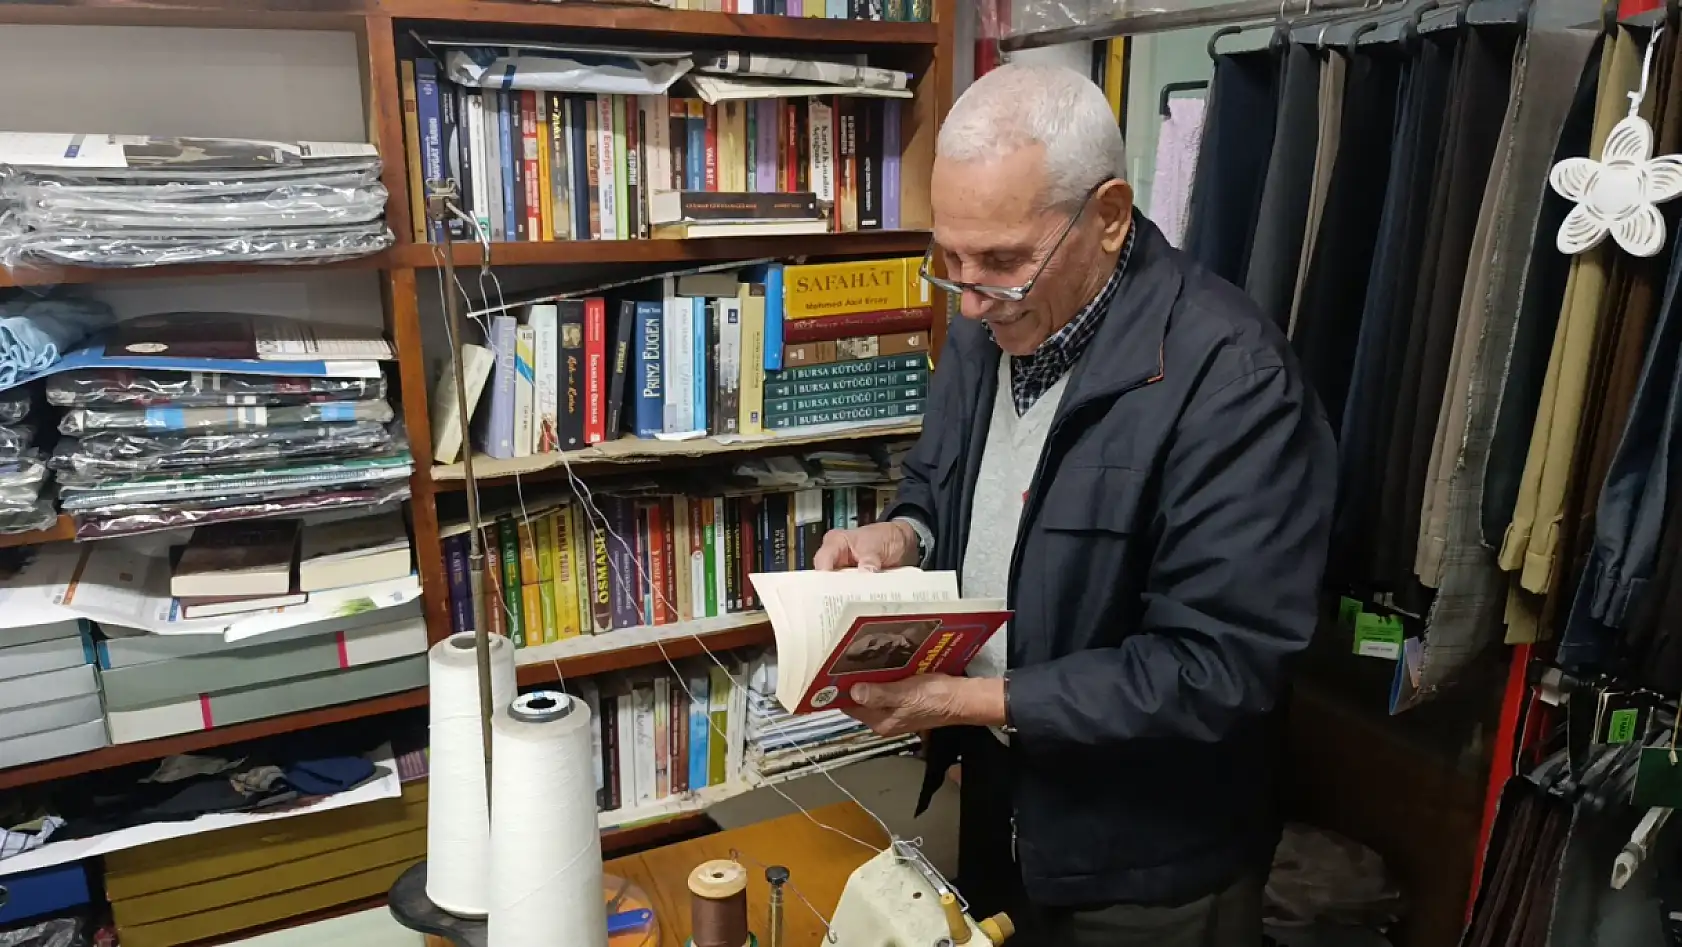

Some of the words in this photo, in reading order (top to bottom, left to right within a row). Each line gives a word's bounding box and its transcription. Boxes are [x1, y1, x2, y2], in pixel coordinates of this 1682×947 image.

[602, 134, 612, 176] Enerjisi
[642, 318, 660, 360] EUGEN
[798, 367, 829, 379] BURSA
[832, 362, 872, 375] KÜTÜĞÜ
[643, 363, 660, 398] PRINZ
[799, 382, 830, 393] BURSA
[833, 377, 873, 390] KÜTÜĞÜ
[798, 397, 829, 409] BURSA
[832, 392, 872, 405] KÜTÜĞÜ
[799, 413, 830, 425] BURSA
[832, 407, 873, 421] KÜTÜĞÜ
